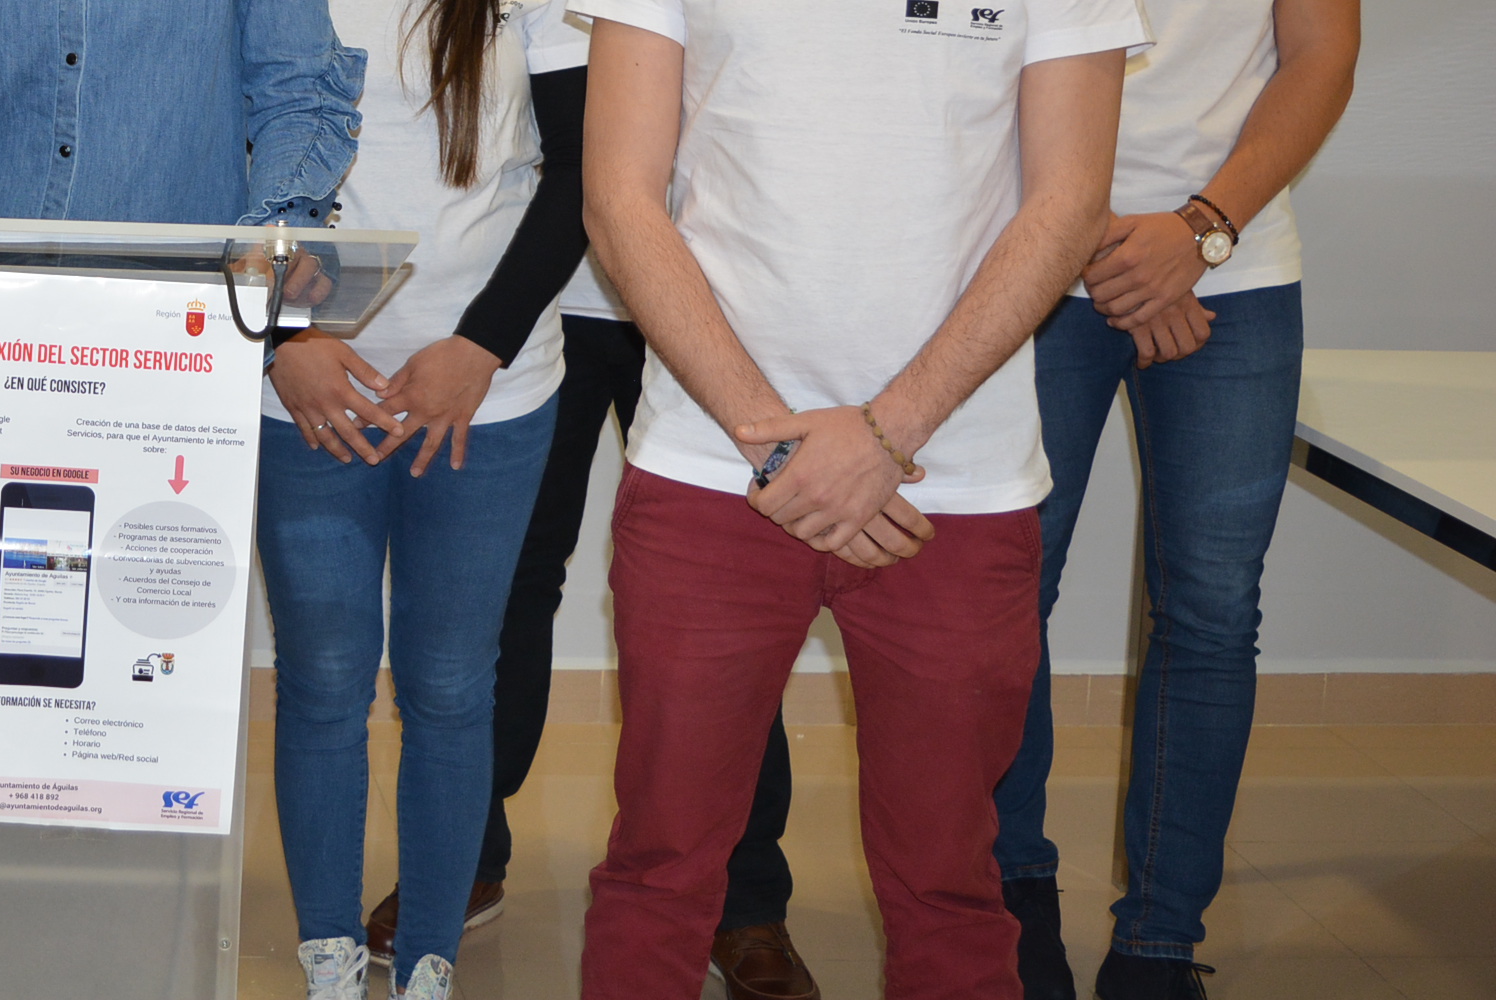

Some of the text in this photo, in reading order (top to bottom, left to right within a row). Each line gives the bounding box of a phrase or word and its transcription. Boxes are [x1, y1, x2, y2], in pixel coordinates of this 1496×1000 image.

[156, 310, 181, 319] Región
[37, 344, 66, 364] DEL
[70, 346, 129, 368] SECTOR
[133, 350, 213, 373] SERVICIOS
[4, 376, 106, 395] ¿EN QUÉ CONSISTE?
[76, 418, 111, 427] Creación
[142, 422, 161, 430] base
[67, 429, 104, 438] Servicios,
[106, 433, 124, 441] para
[152, 435, 204, 444] Ayuntamiento
[216, 438, 245, 446] informe
[10, 466, 89, 479] SU NEGOCIO EN GOOGLE
[124, 523, 153, 531] Posibles
[181, 525, 217, 533] formativos
[118, 533, 157, 542] Programas
[170, 536, 222, 544] asesoramiento
[170, 547, 213, 555] cooperación
[176, 558, 224, 567] subvenciones
[5, 571, 40, 579] Ayuntamiento
[123, 576, 156, 584] Acuerdos
[171, 579, 200, 587] Consejo
[137, 587, 171, 595] Comercio
[139, 598, 179, 606] información
[43, 698, 52, 708] SE
[54, 699, 96, 710] NECESITA?
[74, 717, 144, 728] Correo electrónico
[74, 728, 107, 737] Teléfono
[72, 751, 159, 763] Página web/Red social
[53, 783, 79, 792] Águilas
[15, 792, 29, 800] 968
[46, 793, 60, 801] 892
